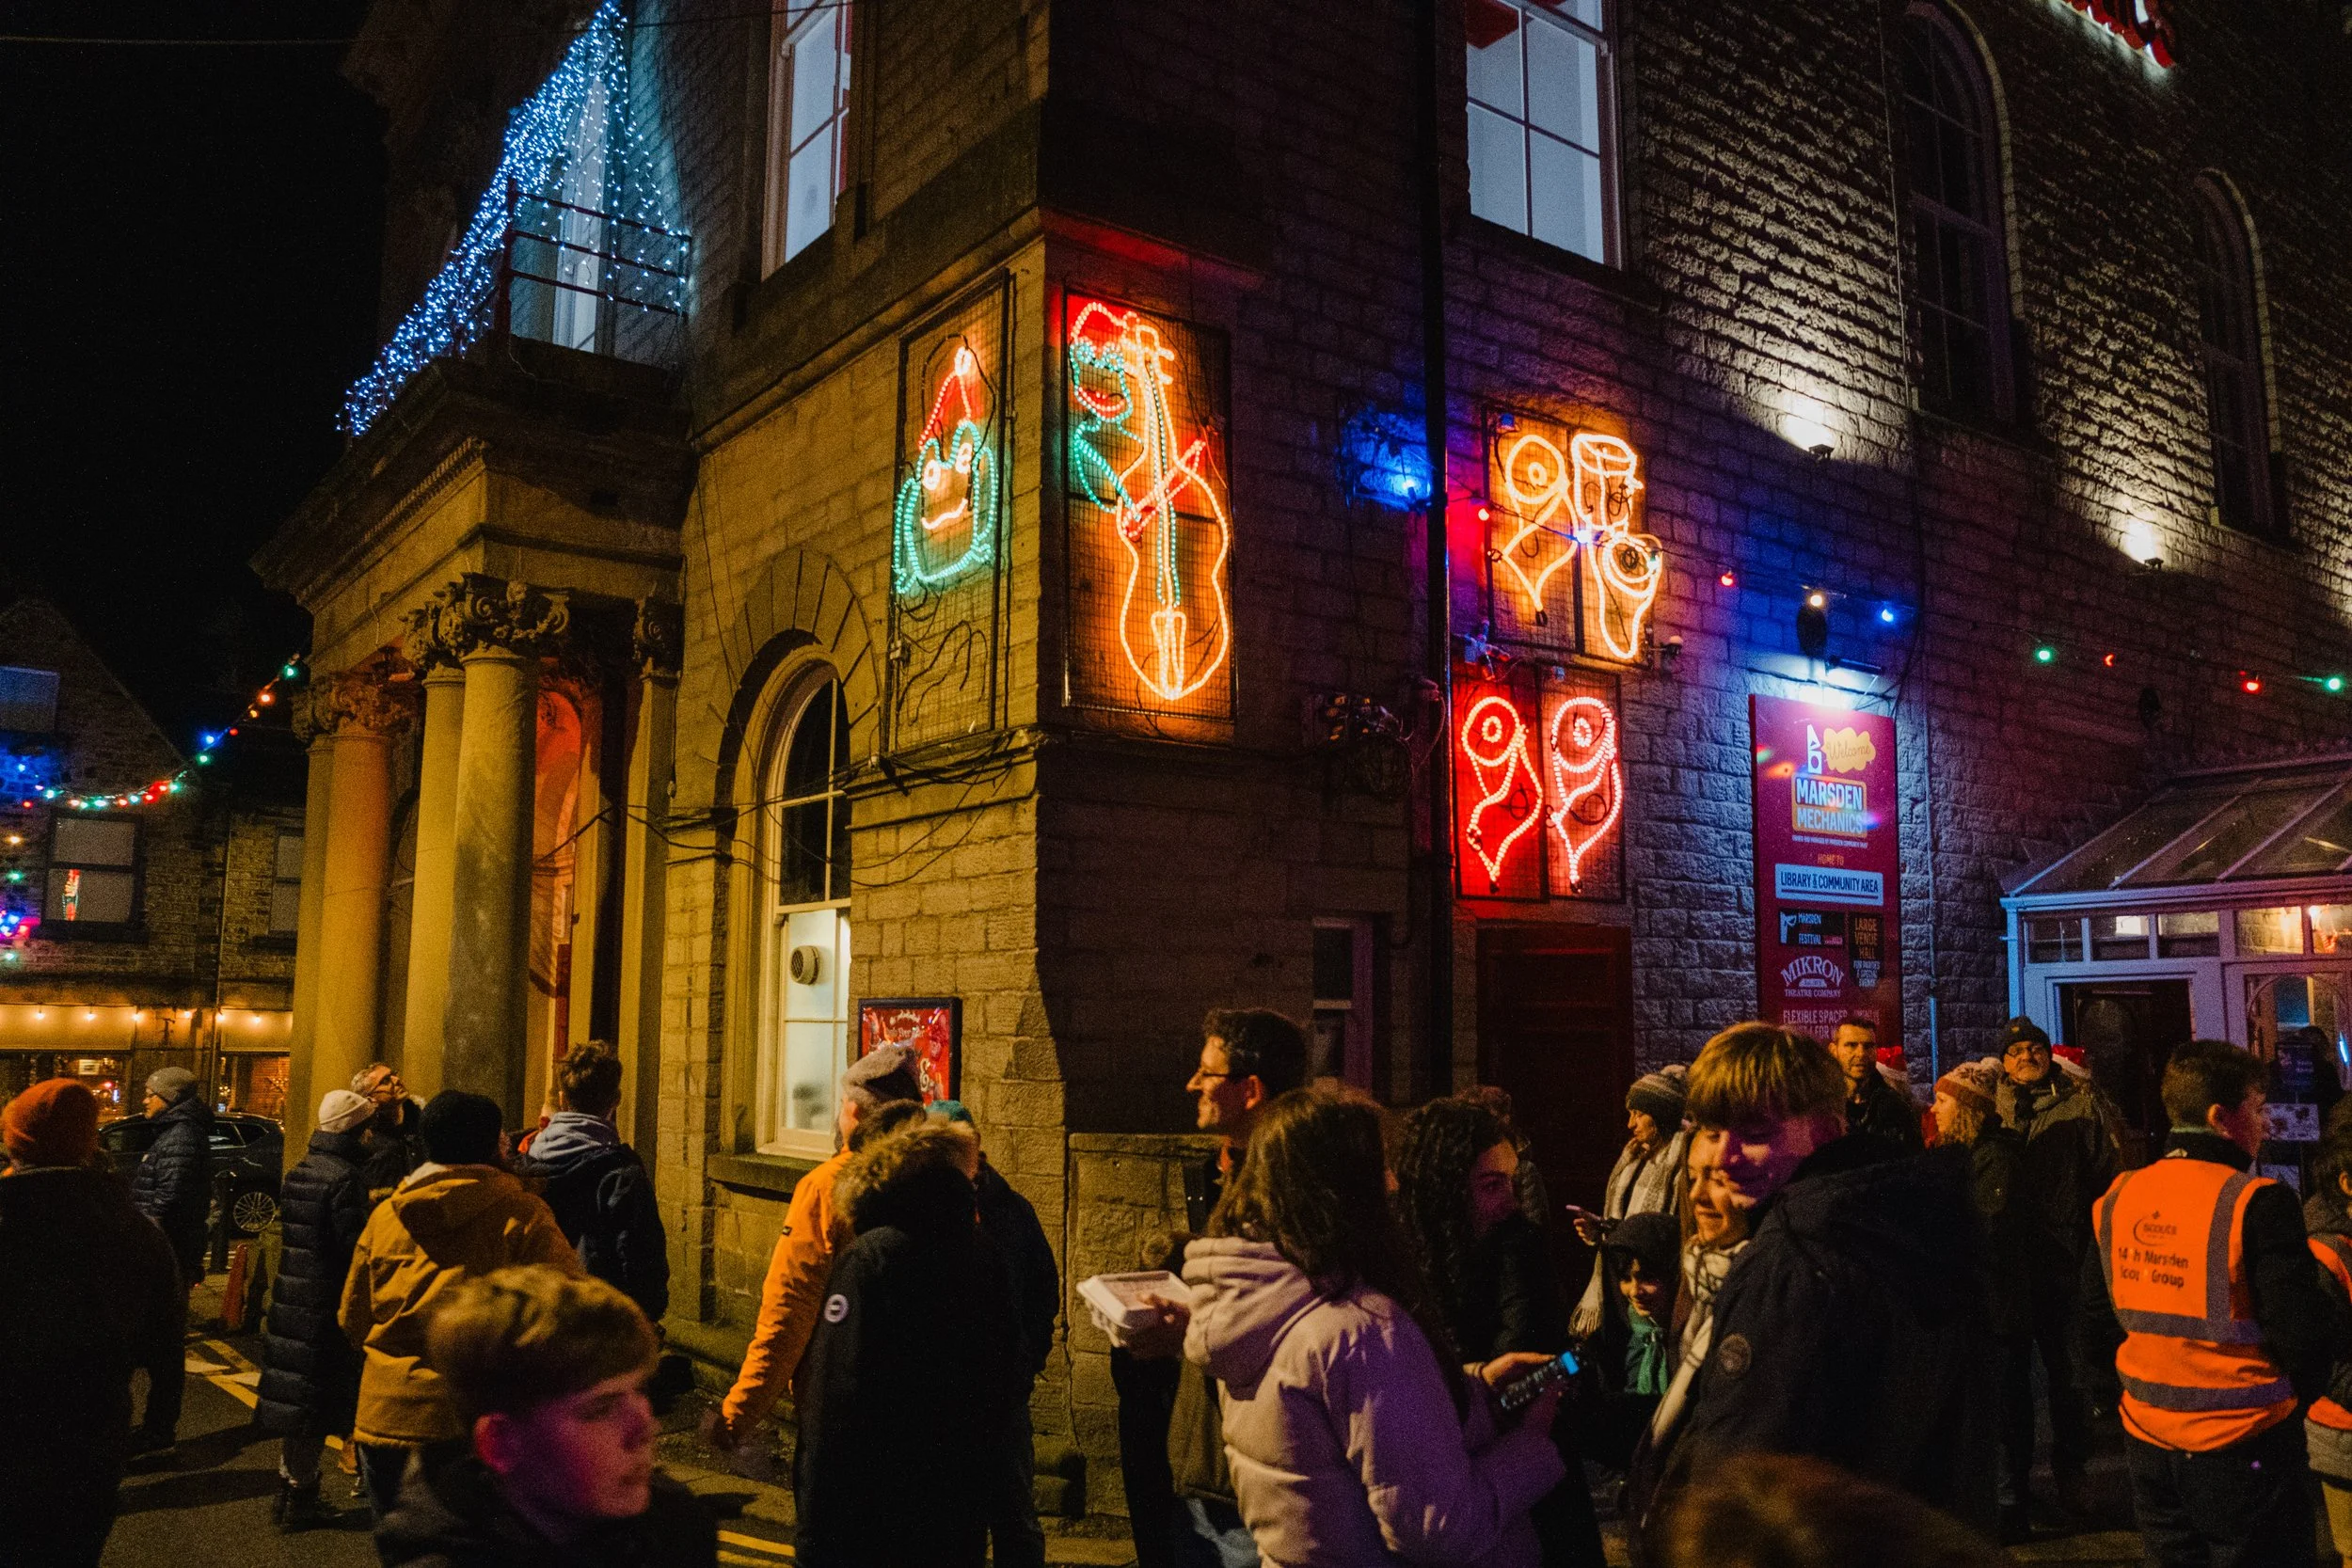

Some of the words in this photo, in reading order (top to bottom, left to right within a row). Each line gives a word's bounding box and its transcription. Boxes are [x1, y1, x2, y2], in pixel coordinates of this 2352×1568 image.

[1827, 740, 1871, 759] Welcome
[1796, 778, 1864, 811] MARSDEN
[1797, 807, 1863, 833] MECHANICS
[1818, 853, 1836, 864] HOME
[1836, 855, 1844, 865] TO
[1781, 872, 1811, 887] LIBRARY
[1819, 875, 1860, 891] COMMUNITY
[1861, 879, 1878, 893] AREA
[1854, 918, 1878, 932] LARGE
[1799, 933, 1821, 944] FESTIVAL
[1780, 956, 1844, 987] MIKRON
[1785, 989, 1812, 997] THEATRE
[1814, 990, 1841, 998] COMPANY
[1783, 1009, 1818, 1024] FLEXIBLE
[2152, 1269, 2185, 1291] Group
